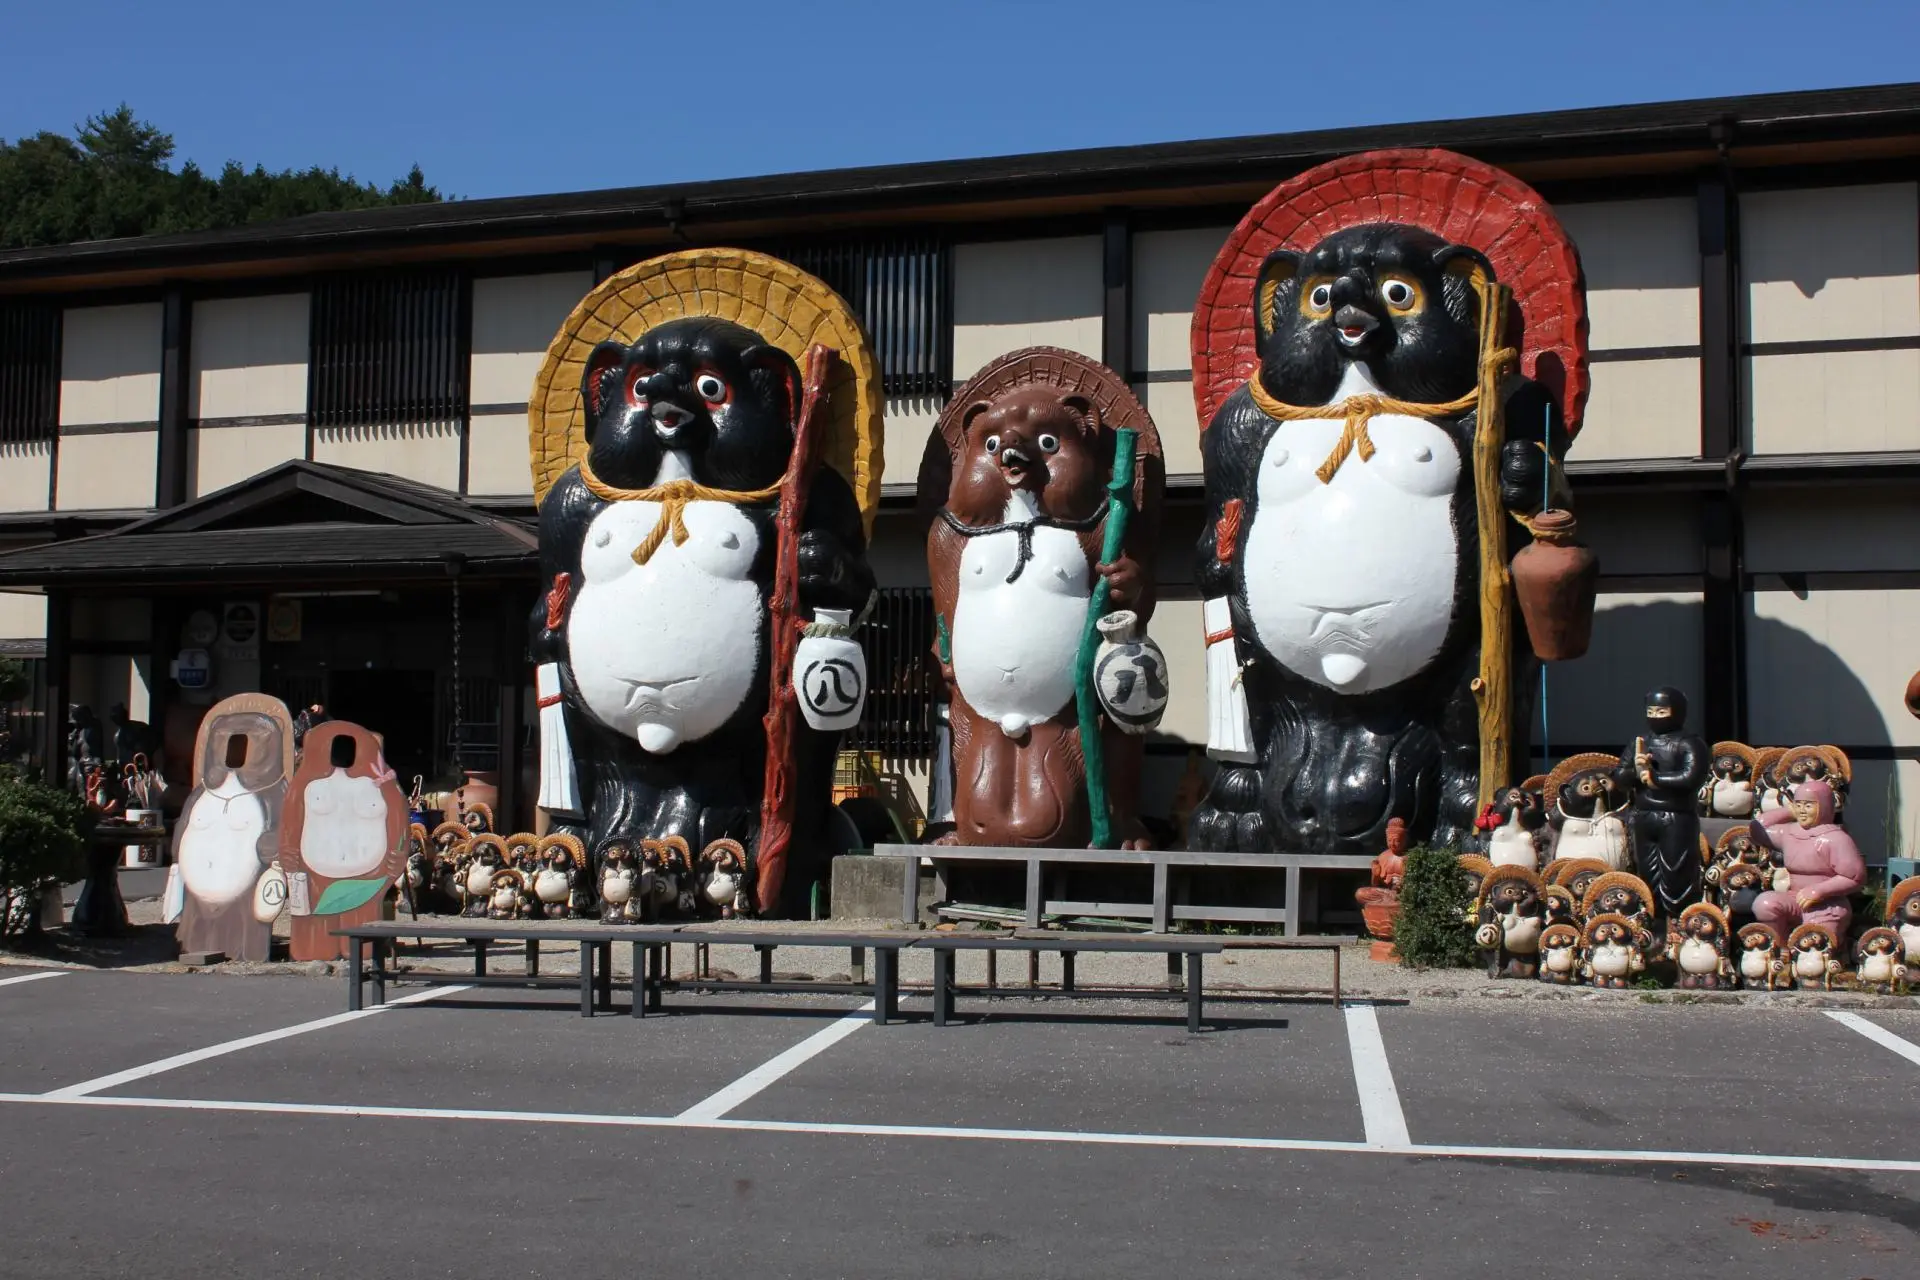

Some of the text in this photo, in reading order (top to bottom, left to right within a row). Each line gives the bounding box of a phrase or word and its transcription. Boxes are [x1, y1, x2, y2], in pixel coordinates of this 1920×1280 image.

[813, 665, 859, 707] 八
[1109, 654, 1167, 704] 八
[265, 882, 284, 899] 八
